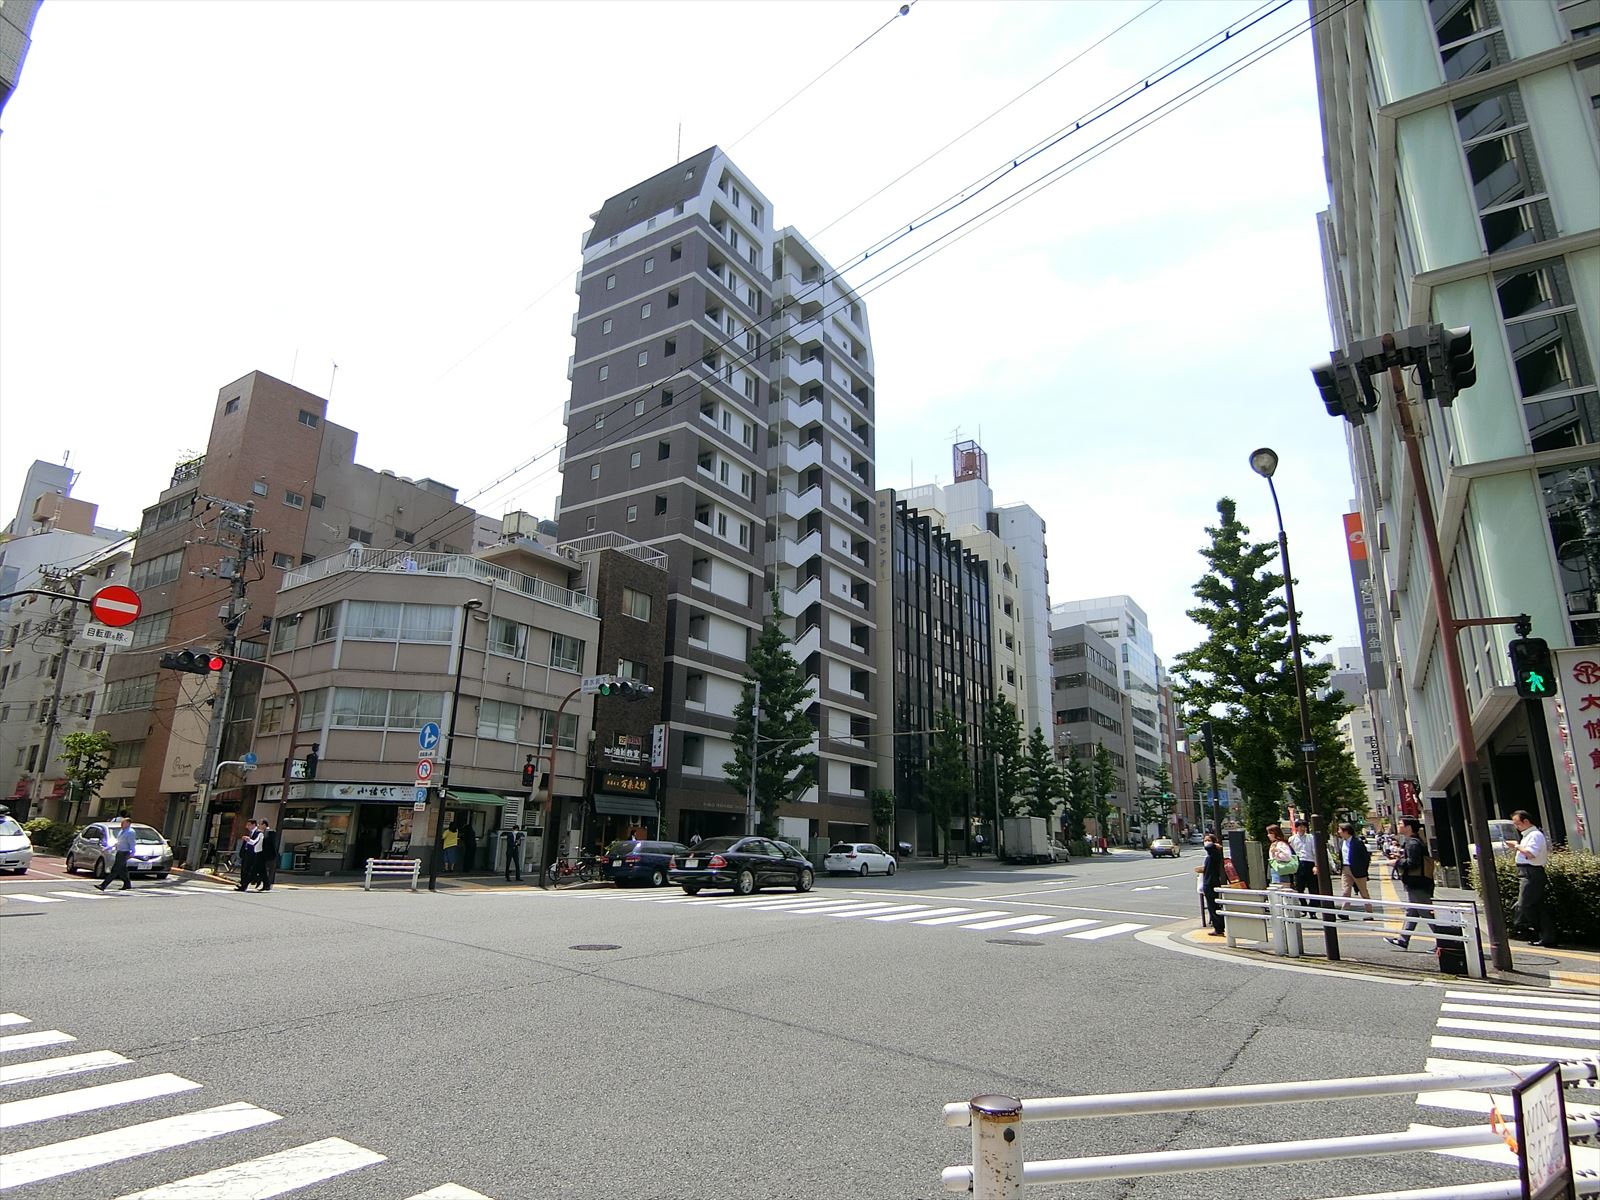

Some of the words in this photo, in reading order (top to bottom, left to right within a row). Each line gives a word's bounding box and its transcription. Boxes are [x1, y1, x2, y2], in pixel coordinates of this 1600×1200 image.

[87, 627, 128, 642] 自転車を除く
